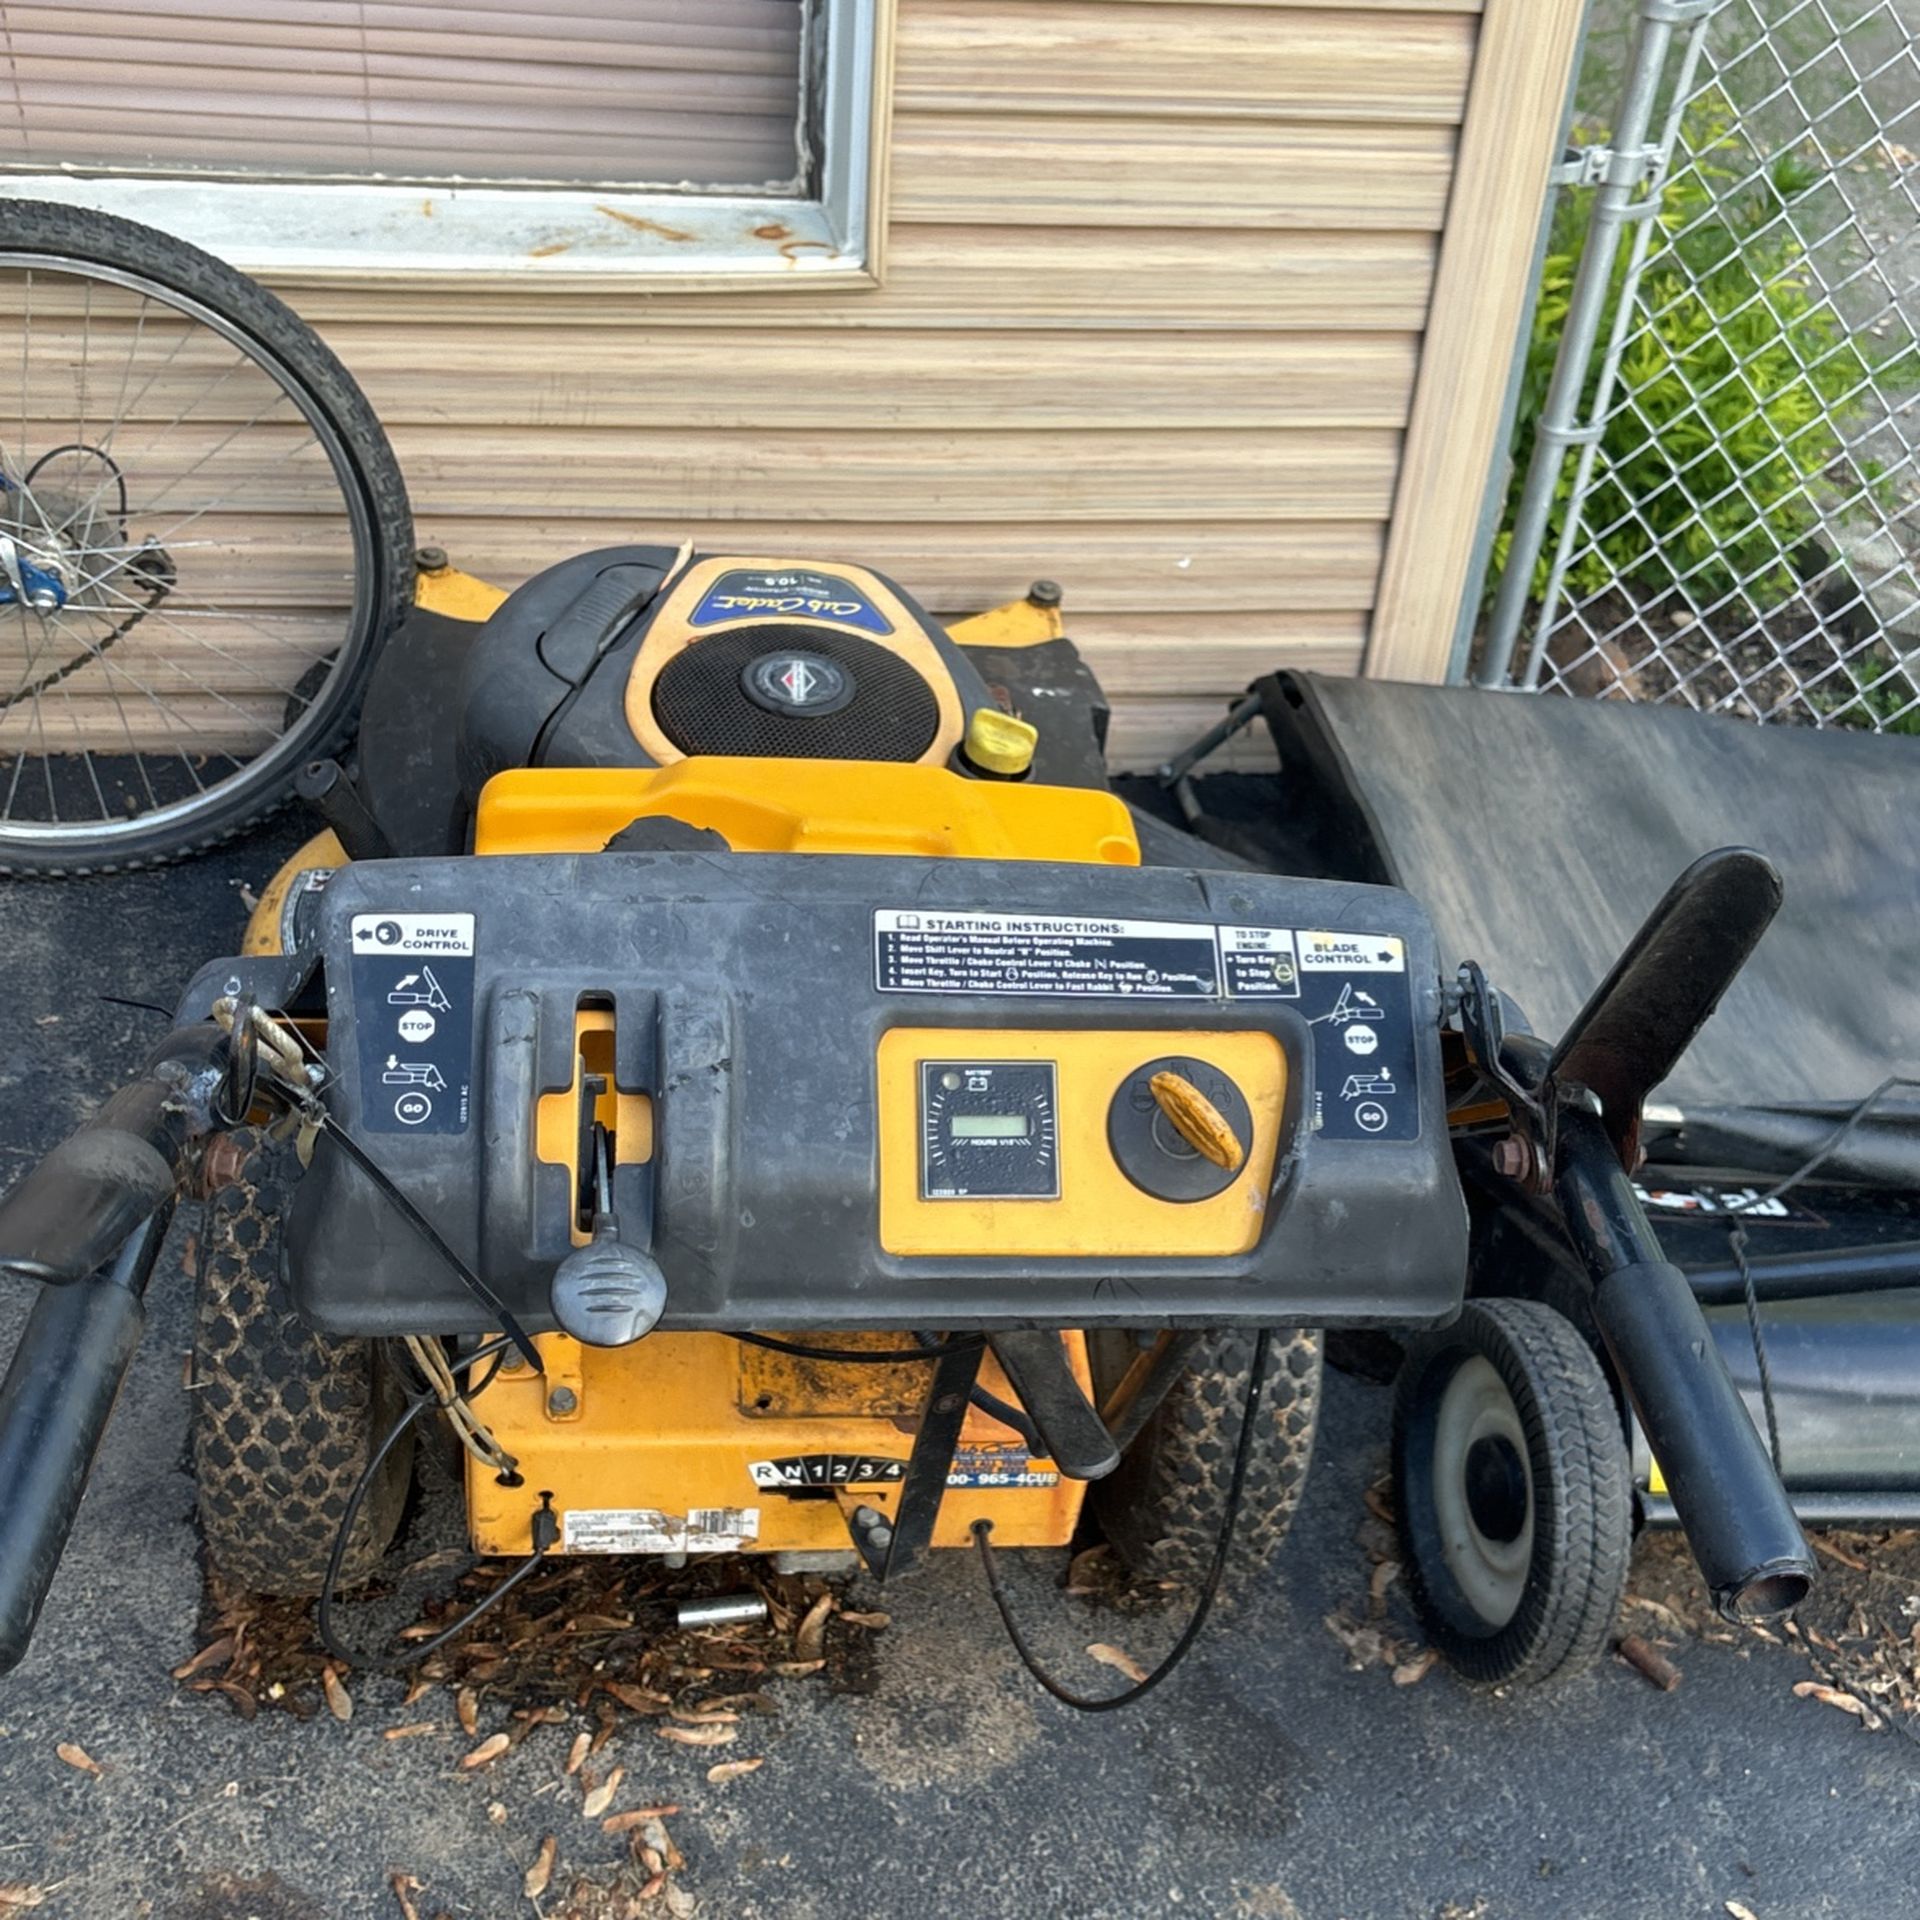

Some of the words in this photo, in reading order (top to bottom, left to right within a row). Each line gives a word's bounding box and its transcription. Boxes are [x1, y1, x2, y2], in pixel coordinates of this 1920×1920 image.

[712, 596, 805, 612] Cadet
[807, 599, 862, 616] Cub
[926, 919, 1002, 932] STARTING
[1006, 922, 1125, 934] INSTRUCTIONS:
[416, 928, 458, 939] DRIVE
[403, 940, 470, 951] CONTROL
[1313, 943, 1359, 953] BLADE
[1304, 952, 1372, 964] CONTROL
[402, 1022, 432, 1031] STOP
[1347, 1035, 1374, 1044] STOP
[403, 1103, 424, 1113] GO
[1361, 1112, 1381, 1121] GO
[757, 1466, 773, 1478] R
[785, 1465, 801, 1478] N
[813, 1465, 823, 1477] 1
[833, 1465, 847, 1477] 2
[860, 1464, 874, 1477] 3
[885, 1464, 900, 1476] 4
